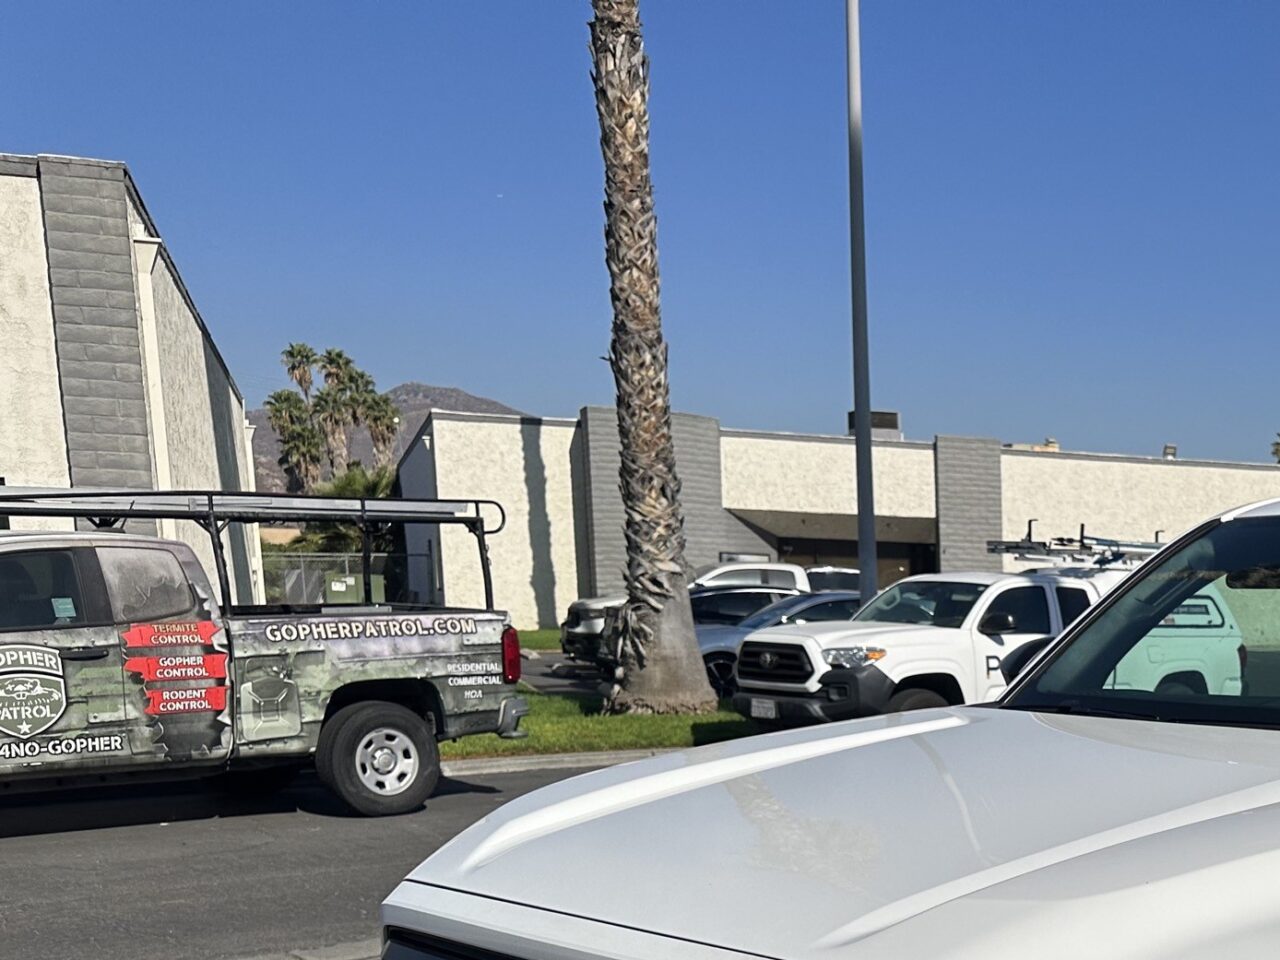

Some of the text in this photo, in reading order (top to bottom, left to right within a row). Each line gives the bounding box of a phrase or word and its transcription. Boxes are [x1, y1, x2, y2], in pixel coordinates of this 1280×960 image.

[152, 624, 198, 633] TERMITE
[265, 618, 477, 642] GOPHERPATROL.COM
[151, 635, 204, 644] CONTROL
[159, 656, 204, 666] GOPHER
[447, 662, 499, 672] RESIDENTIAL
[156, 668, 209, 678] CONTROL
[448, 676, 502, 686] COMMERCIAL
[162, 689, 206, 700] RODENT
[159, 700, 211, 711] CONTROL
[0, 705, 57, 720] ATROL
